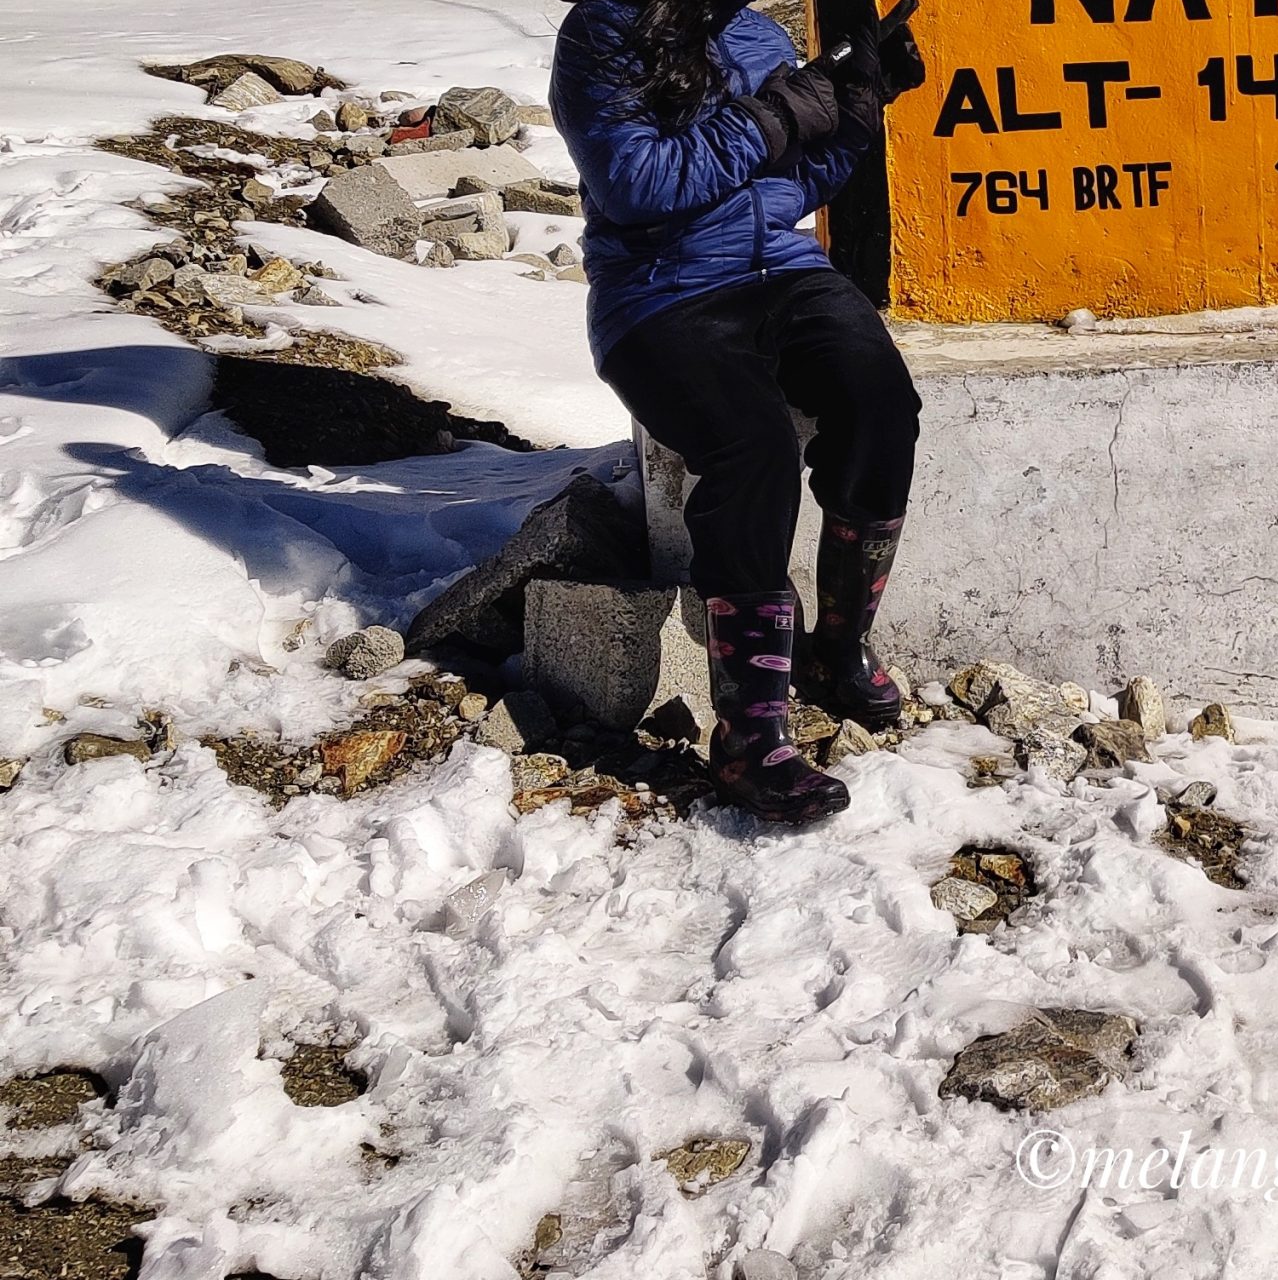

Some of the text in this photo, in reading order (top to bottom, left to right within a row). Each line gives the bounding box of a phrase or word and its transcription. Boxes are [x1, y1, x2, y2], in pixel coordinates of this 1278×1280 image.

[933, 61, 1162, 138] ALT-
[950, 161, 1172, 217] 764 BRTF
